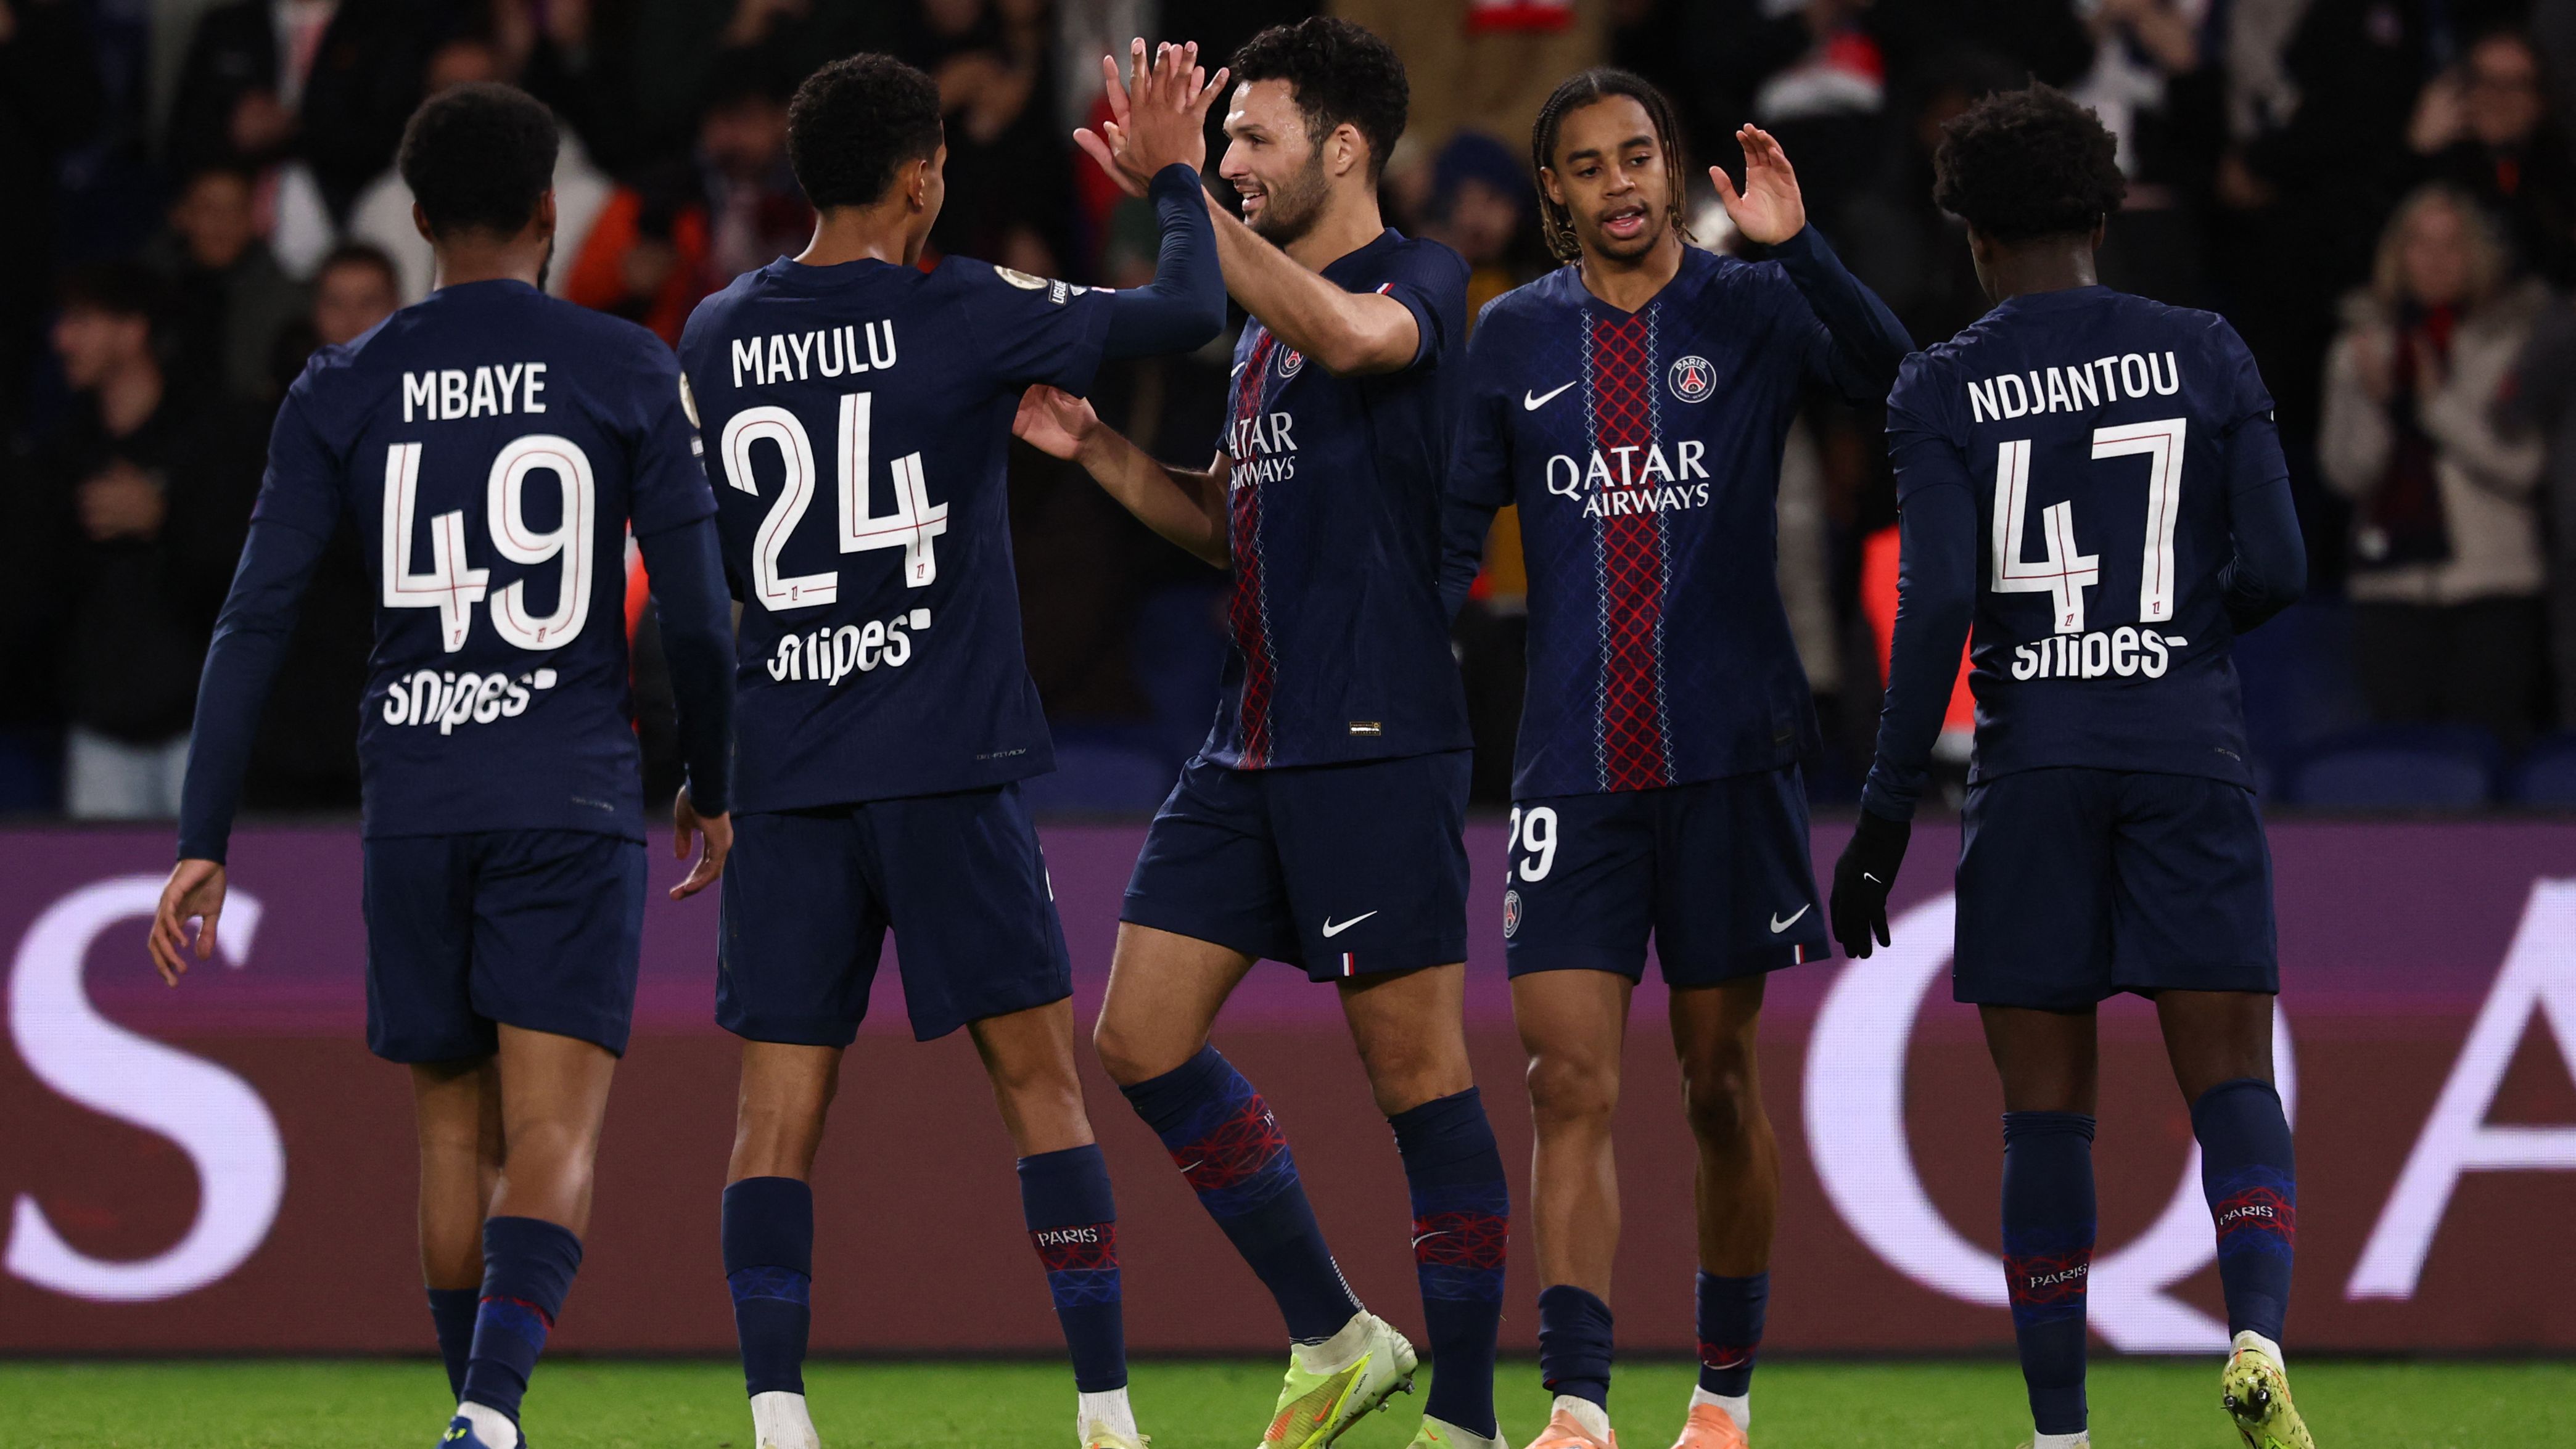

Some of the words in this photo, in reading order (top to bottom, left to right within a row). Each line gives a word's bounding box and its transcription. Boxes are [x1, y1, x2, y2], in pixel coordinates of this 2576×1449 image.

[732, 319, 897, 388] MAYULU
[1676, 358, 1707, 371] PARIS
[403, 363, 547, 423] MBAYE
[1967, 351, 2179, 423] NDJANTOU
[1225, 412, 1298, 460] ATAR
[721, 392, 949, 612] 24
[1230, 456, 1296, 491] AIRWAYS
[1547, 440, 1710, 502] QATAR
[1582, 483, 1710, 519] AIRWAYS
[382, 434, 595, 653] 49
[1991, 417, 2187, 634] 47
[767, 615, 911, 686] snipes
[383, 670, 531, 736] snipes
[4, 873, 288, 1305] S
[1037, 1228, 1098, 1247] PARIS
[2220, 1205, 2273, 1226] PARIS
[2031, 1263, 2088, 1288] PARIS
